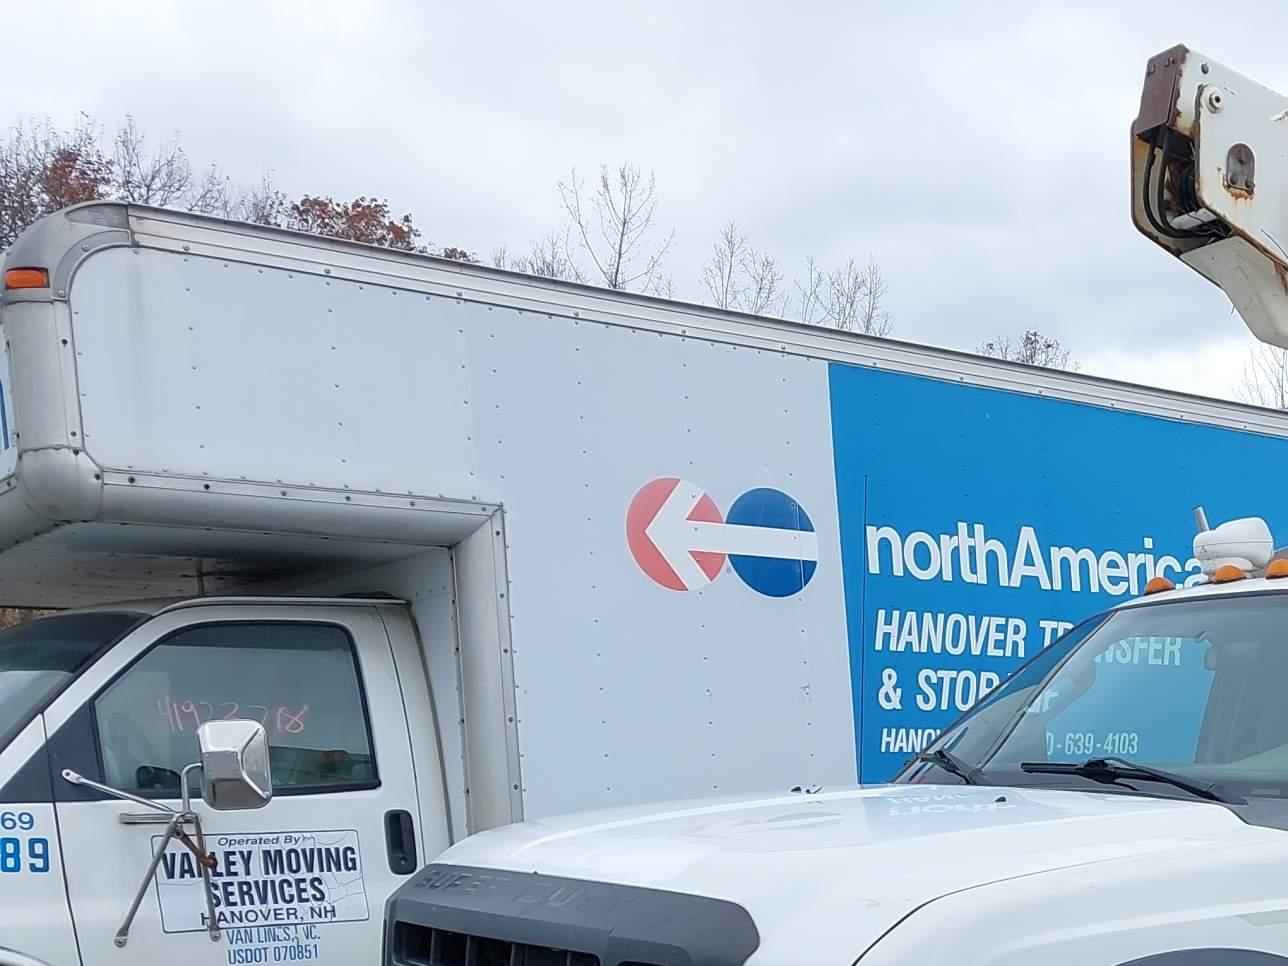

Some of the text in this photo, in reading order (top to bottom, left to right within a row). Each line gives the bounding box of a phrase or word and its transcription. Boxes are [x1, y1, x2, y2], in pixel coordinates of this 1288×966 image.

[875, 609, 1025, 658] HANOVER
[878, 668, 902, 710] &
[0, 811, 34, 830] 69
[217, 835, 279, 848] Operated
[0, 837, 50, 873] 89
[261, 846, 358, 876] MOVING
[212, 876, 326, 908] SERVICES
[310, 905, 337, 919] NH
[226, 928, 253, 945] VAN
[228, 943, 319, 965] USDOT 070851
